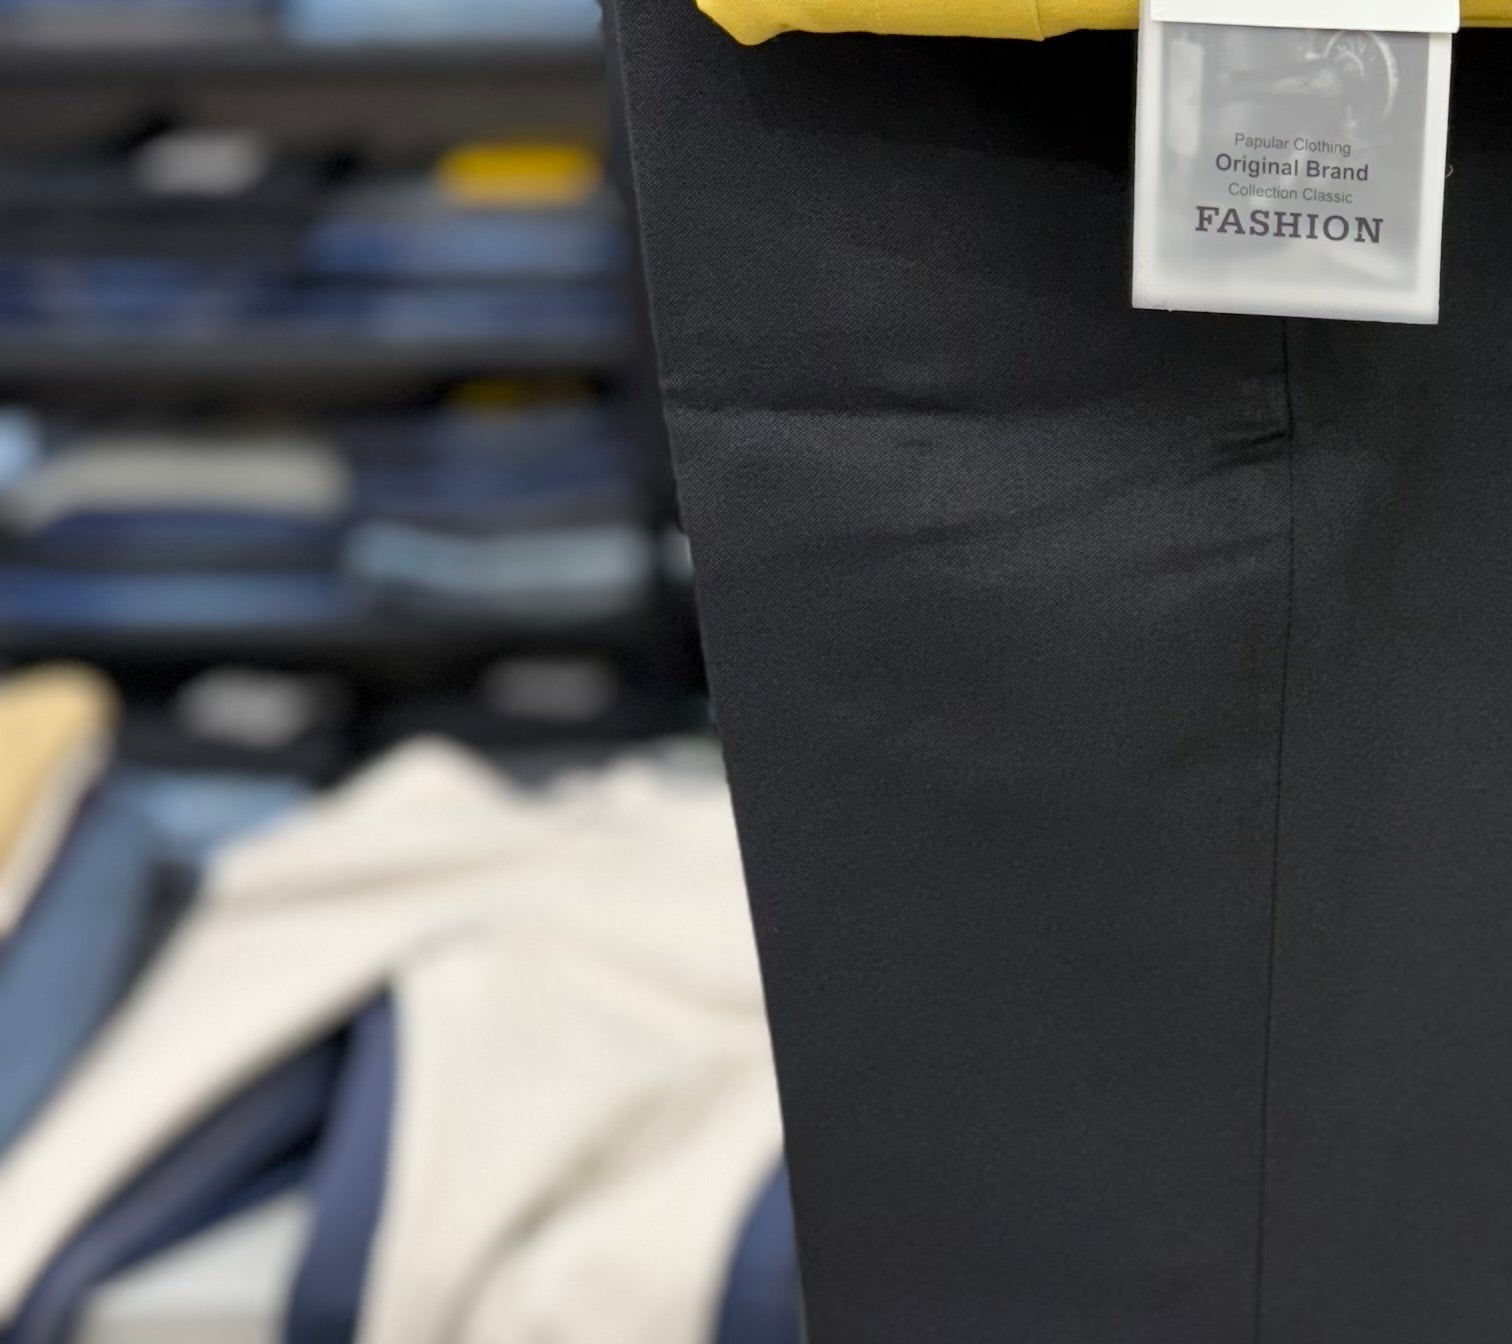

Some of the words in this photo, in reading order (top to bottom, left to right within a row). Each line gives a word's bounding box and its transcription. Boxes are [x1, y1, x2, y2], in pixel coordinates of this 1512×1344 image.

[1234, 132, 1290, 151] Papular
[1293, 136, 1352, 156] Clothing
[1215, 153, 1299, 178] Original
[1306, 159, 1370, 182] Brand
[1228, 182, 1298, 201] Collection
[1302, 187, 1353, 205] Classic
[1194, 205, 1384, 244] FASHION
